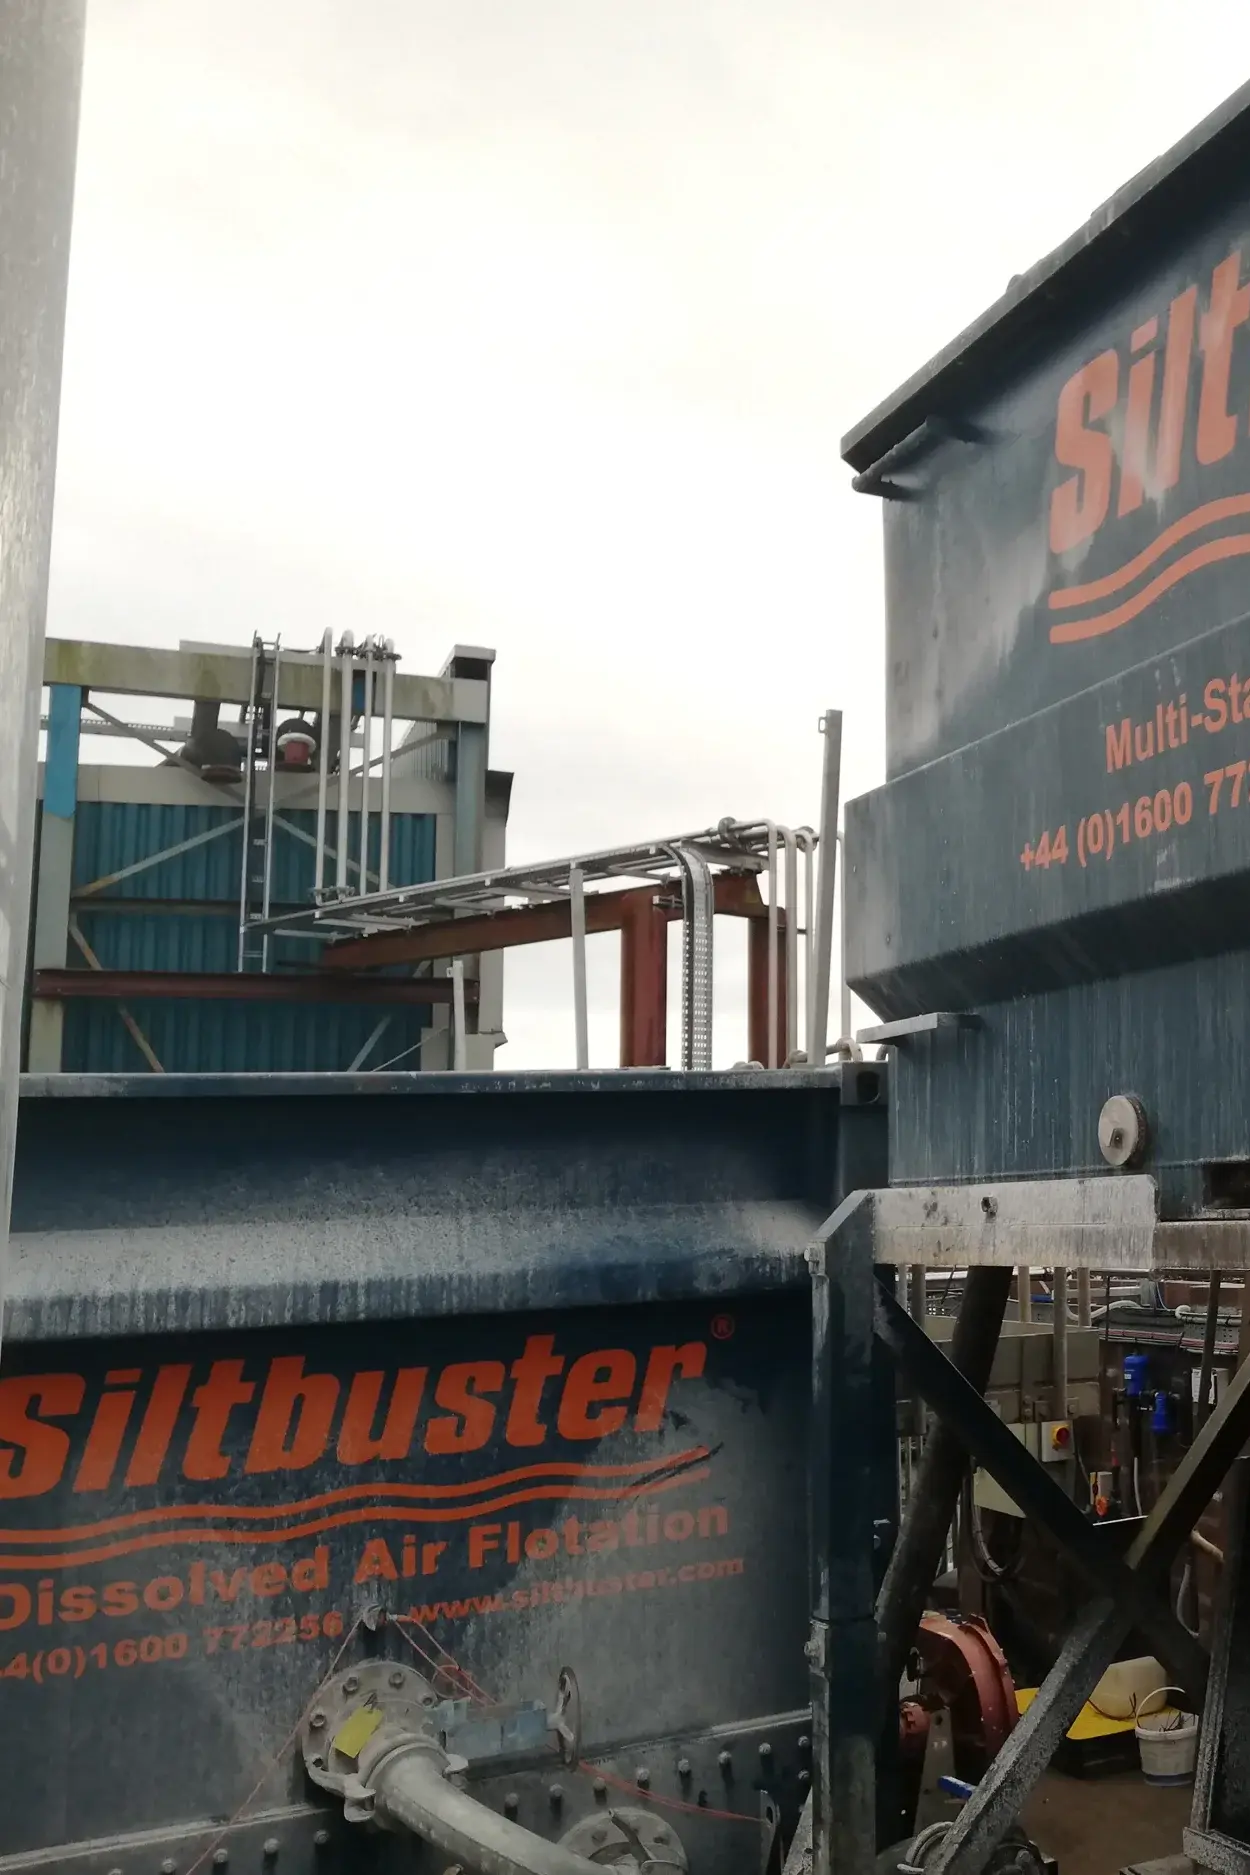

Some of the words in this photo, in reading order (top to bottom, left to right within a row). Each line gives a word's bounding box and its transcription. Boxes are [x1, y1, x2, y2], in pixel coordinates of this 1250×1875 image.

[1019, 825, 1069, 872] +44
[1077, 782, 1194, 868] (0)1600
[0, 1334, 708, 1498] Siltbuster
[0, 1545, 332, 1632] Dissolved
[353, 1533, 449, 1584] Air
[467, 1504, 730, 1569] Flotation
[0, 1633, 190, 1684] 4(0)1600
[203, 1611, 345, 1655] 772256
[408, 1556, 745, 1624] www.siltbuster.com
